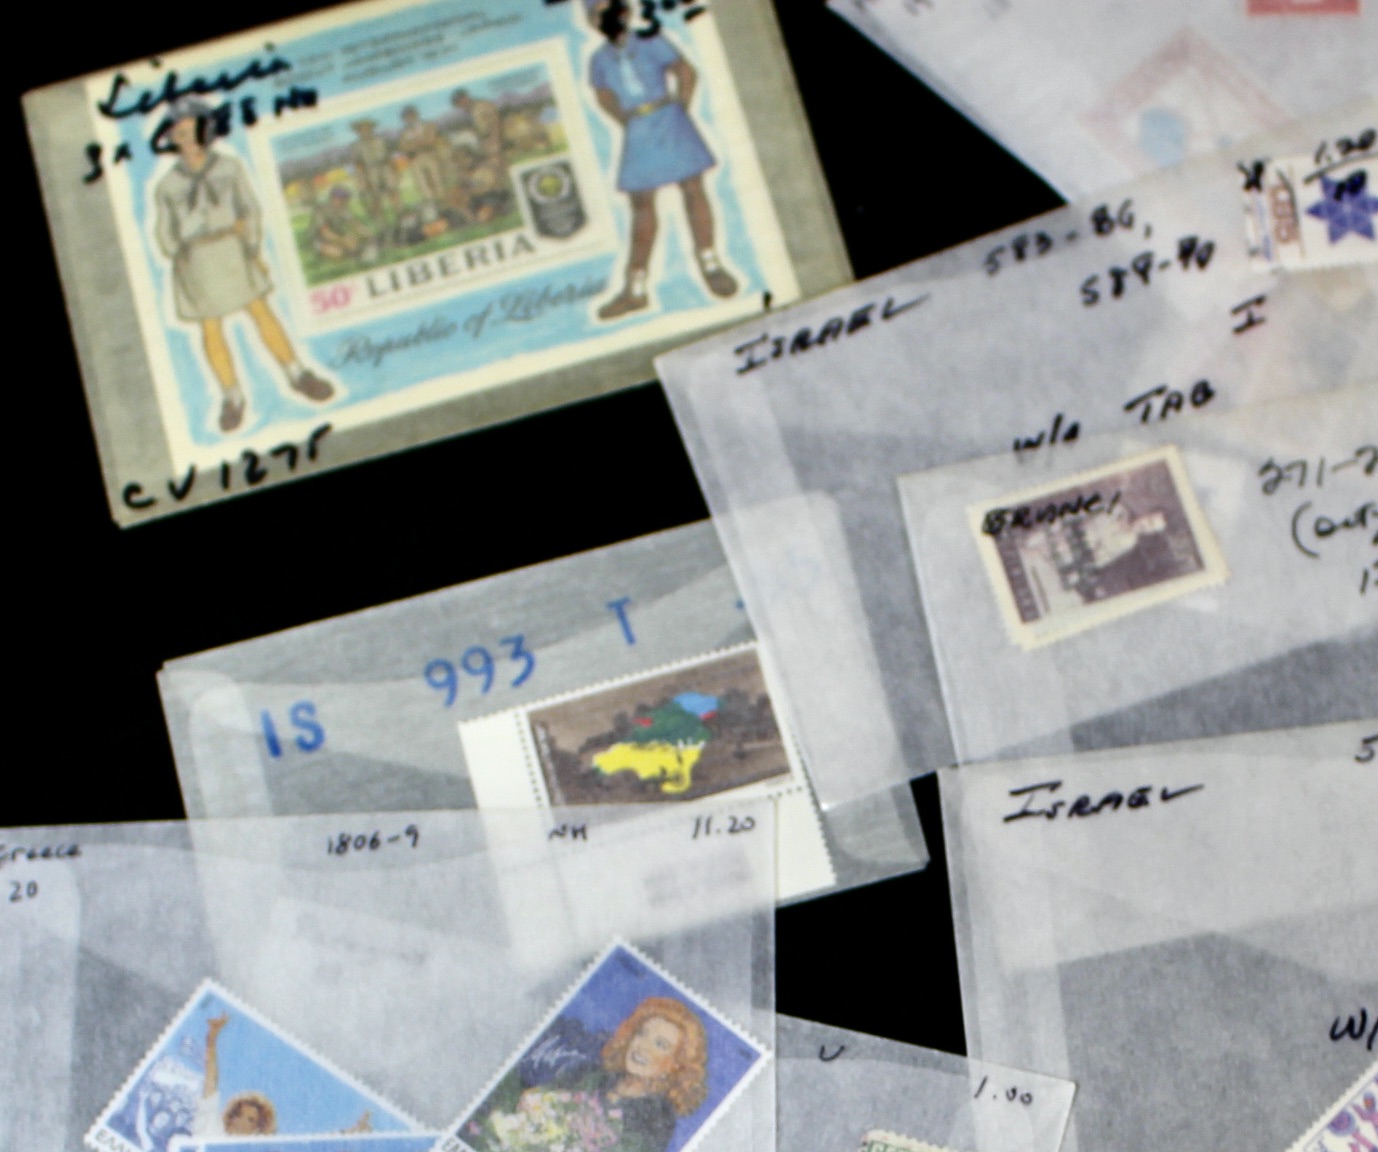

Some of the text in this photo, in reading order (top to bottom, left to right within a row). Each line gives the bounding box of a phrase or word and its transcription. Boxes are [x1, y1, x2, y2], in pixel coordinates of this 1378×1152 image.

[364, 231, 538, 299] LIBERIA
[424, 634, 537, 707] 993
[608, 598, 637, 647] T
